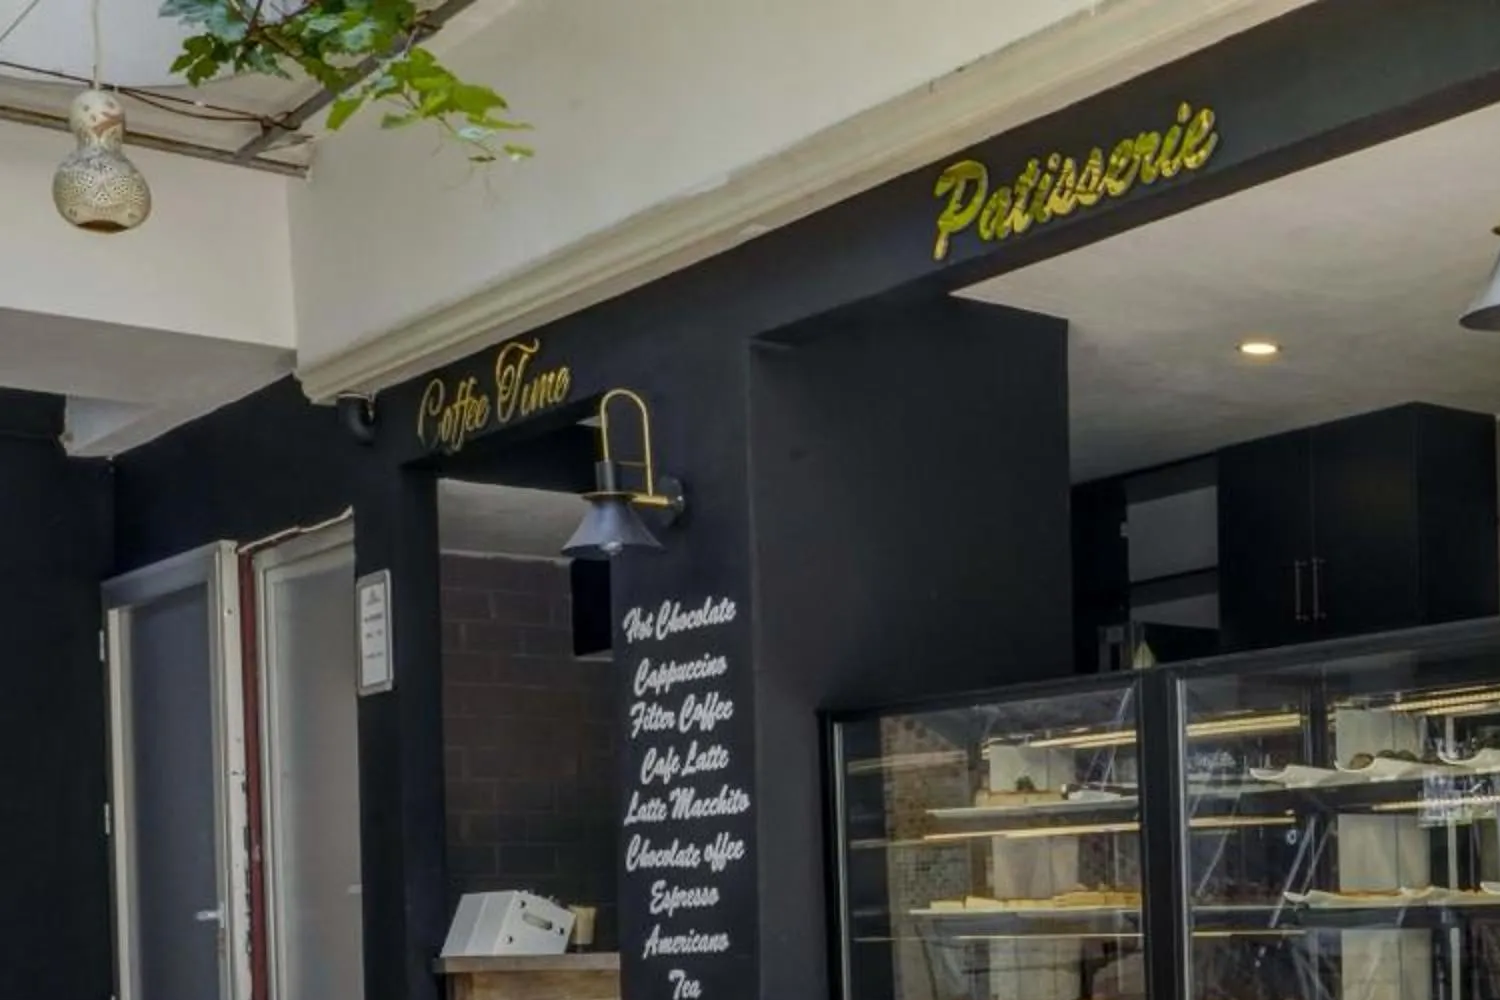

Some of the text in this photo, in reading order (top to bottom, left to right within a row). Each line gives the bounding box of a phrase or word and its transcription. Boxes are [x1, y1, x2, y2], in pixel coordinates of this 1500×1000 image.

[933, 101, 1218, 260] Patisserie
[417, 338, 570, 454] Coffee Time
[623, 596, 736, 644] Hot Chocolate
[634, 653, 728, 697] Cappuccino
[678, 692, 733, 733] Coffee
[640, 740, 728, 785] Cafe Latte
[624, 791, 667, 826] Latte
[626, 832, 744, 872] Chocolate offee
[650, 880, 719, 917] Espresso
[642, 924, 730, 959] Americano
[668, 969, 702, 1000] Tea
